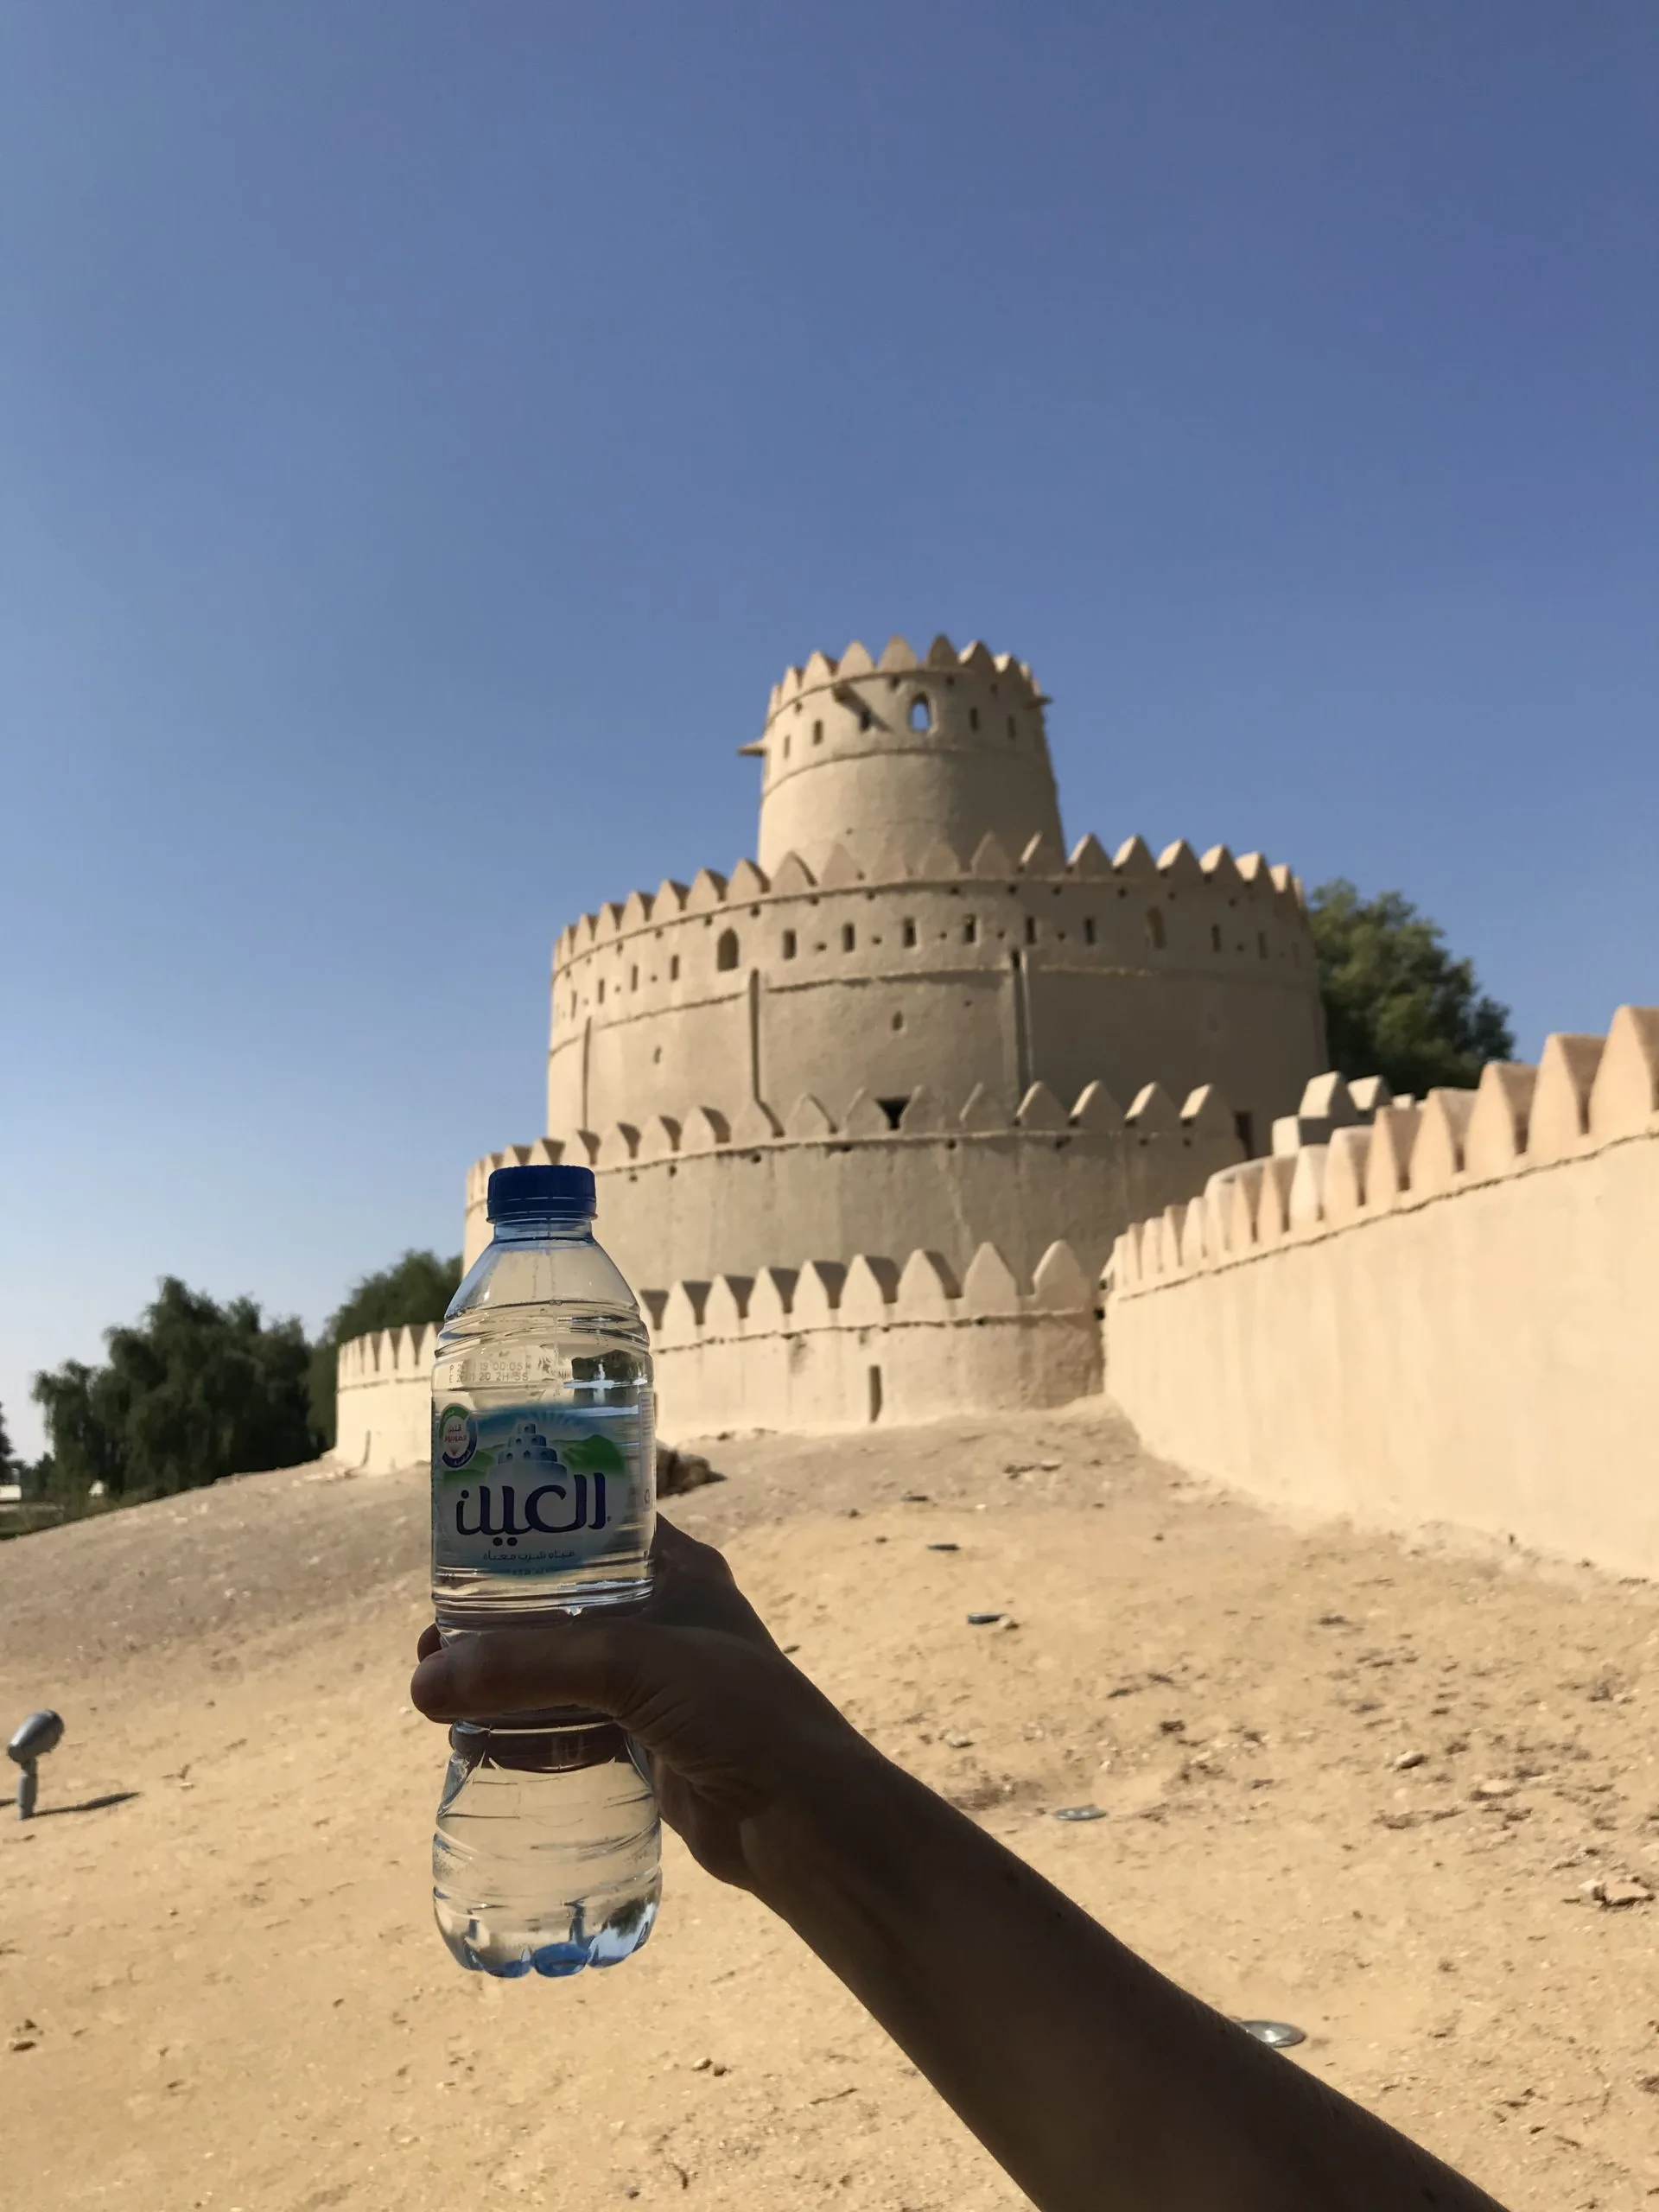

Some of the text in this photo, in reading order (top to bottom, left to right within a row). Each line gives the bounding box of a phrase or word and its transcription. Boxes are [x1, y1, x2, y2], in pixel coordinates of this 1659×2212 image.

[479, 1371, 492, 1382] 20
[456, 1472, 606, 1547] العين
[517, 1550, 547, 1562] شرب
[548, 1548, 575, 1560] مياه
